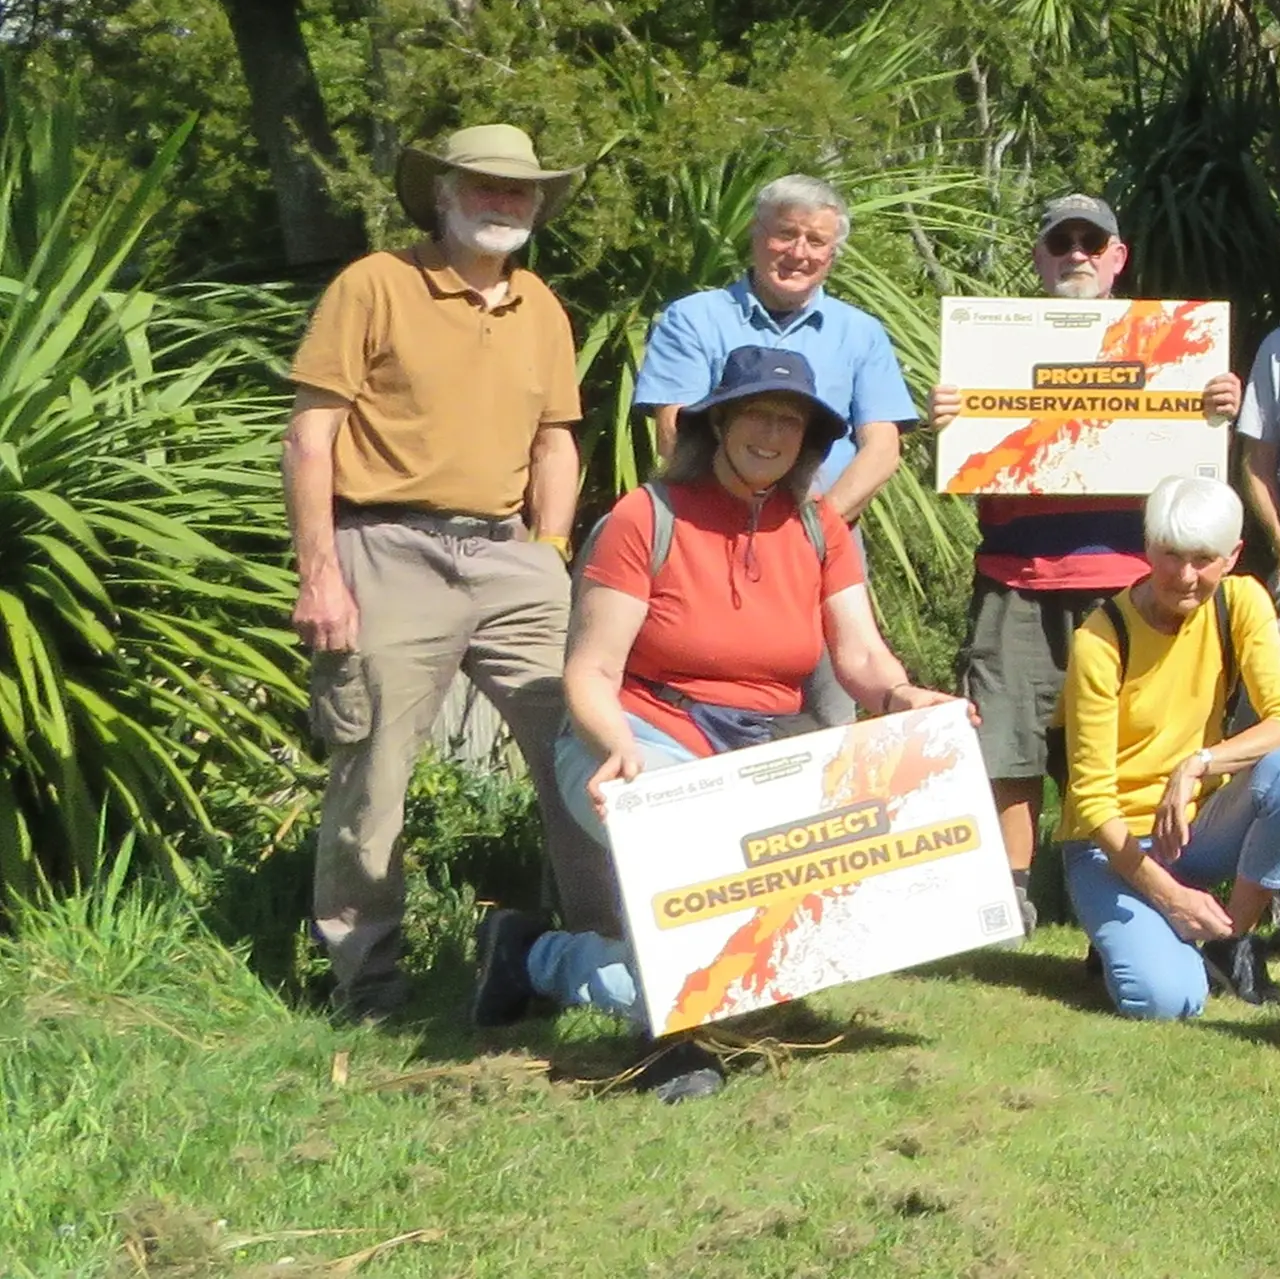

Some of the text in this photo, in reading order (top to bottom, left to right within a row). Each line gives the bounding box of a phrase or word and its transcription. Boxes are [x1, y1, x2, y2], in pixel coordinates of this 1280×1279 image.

[1036, 366, 1141, 385] PROTECT
[966, 395, 1204, 412] CONSERVATION LAND
[645, 785, 685, 803] Forest
[699, 776, 724, 790] Bird
[748, 806, 881, 861] PROTECT
[663, 823, 973, 919] CONSERVATION LAND
